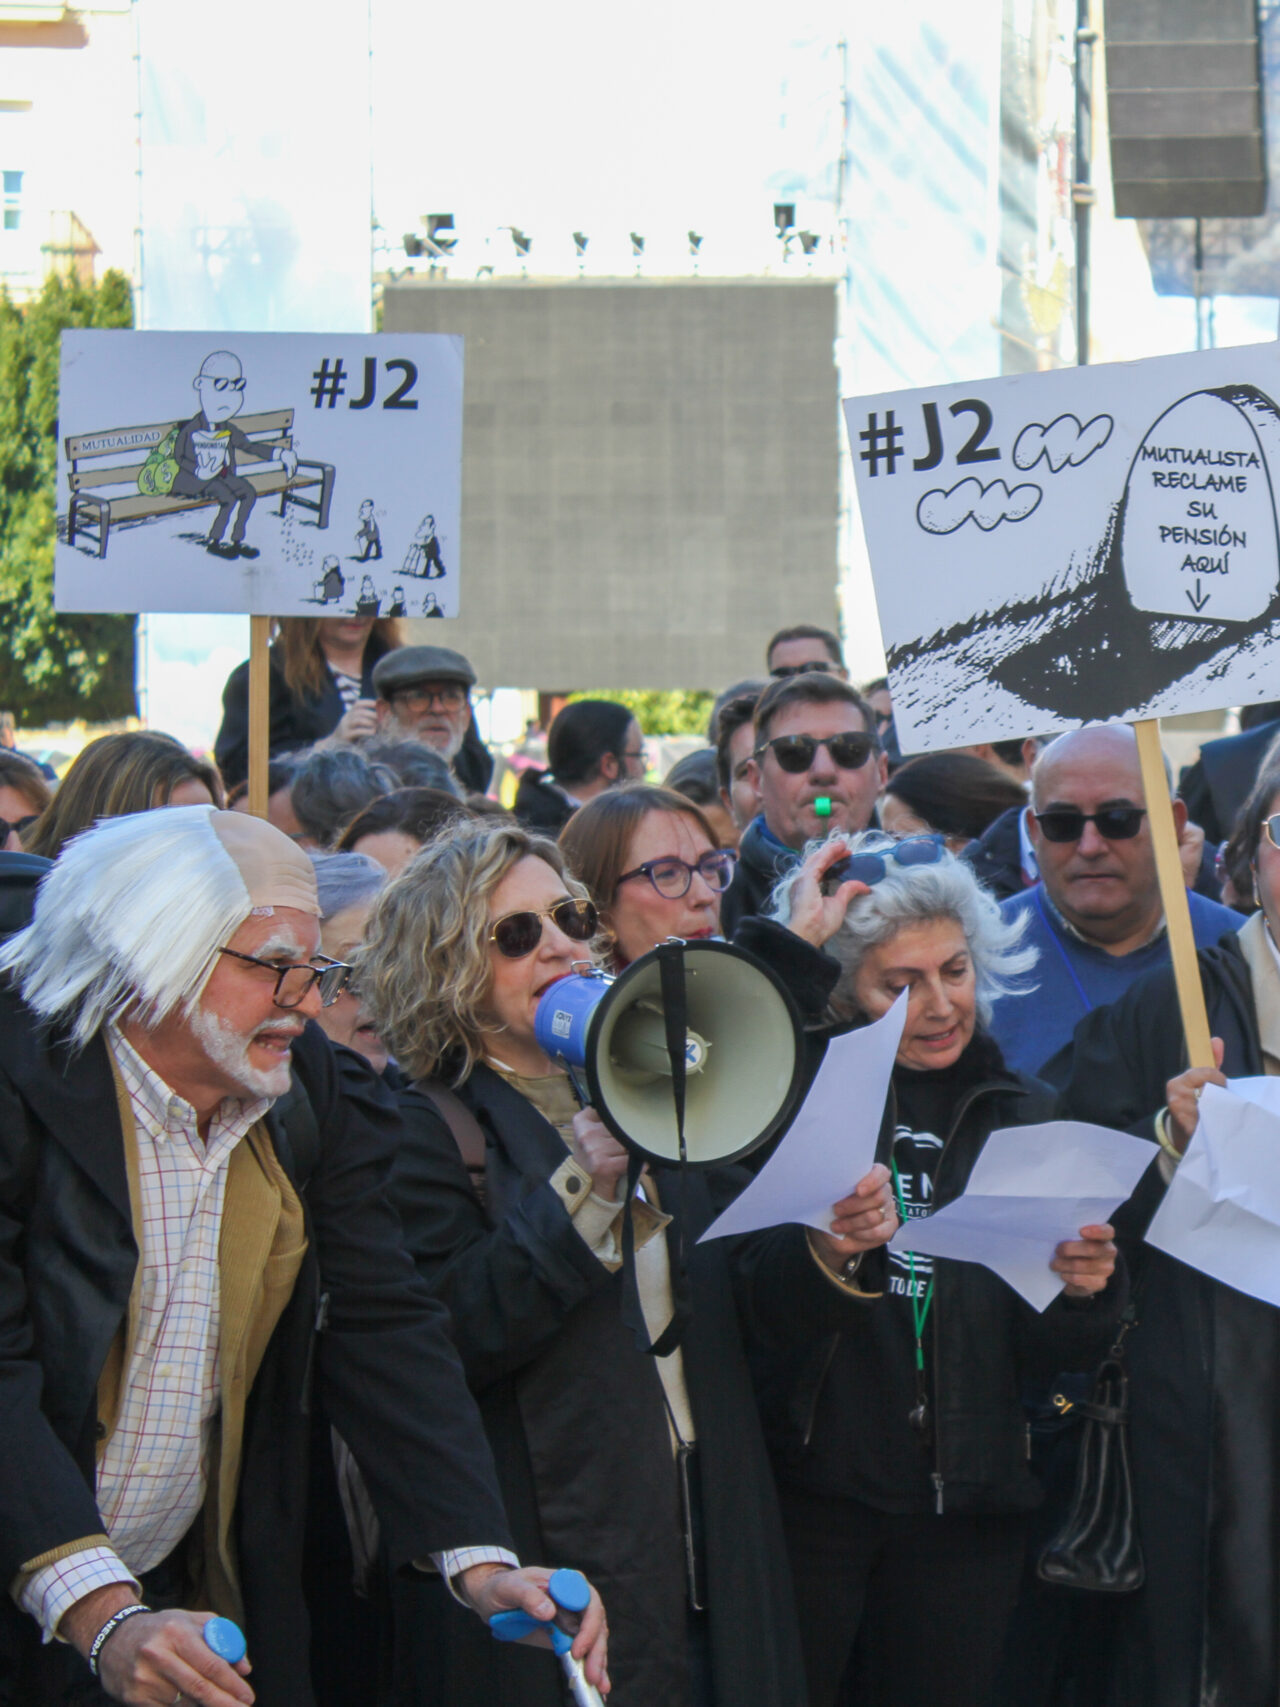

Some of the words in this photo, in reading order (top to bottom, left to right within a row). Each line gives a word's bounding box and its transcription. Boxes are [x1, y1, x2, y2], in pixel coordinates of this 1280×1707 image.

[310, 357, 419, 410] #J2
[82, 431, 161, 450] MUTUALIDAD
[859, 398, 1002, 477] #J2
[1141, 446, 1261, 469] MUTUALISTA
[1152, 472, 1248, 493] RECLAME
[1186, 501, 1218, 520] SU
[1159, 524, 1247, 548] PENSIÓN
[1180, 552, 1229, 574] AQUÍ
